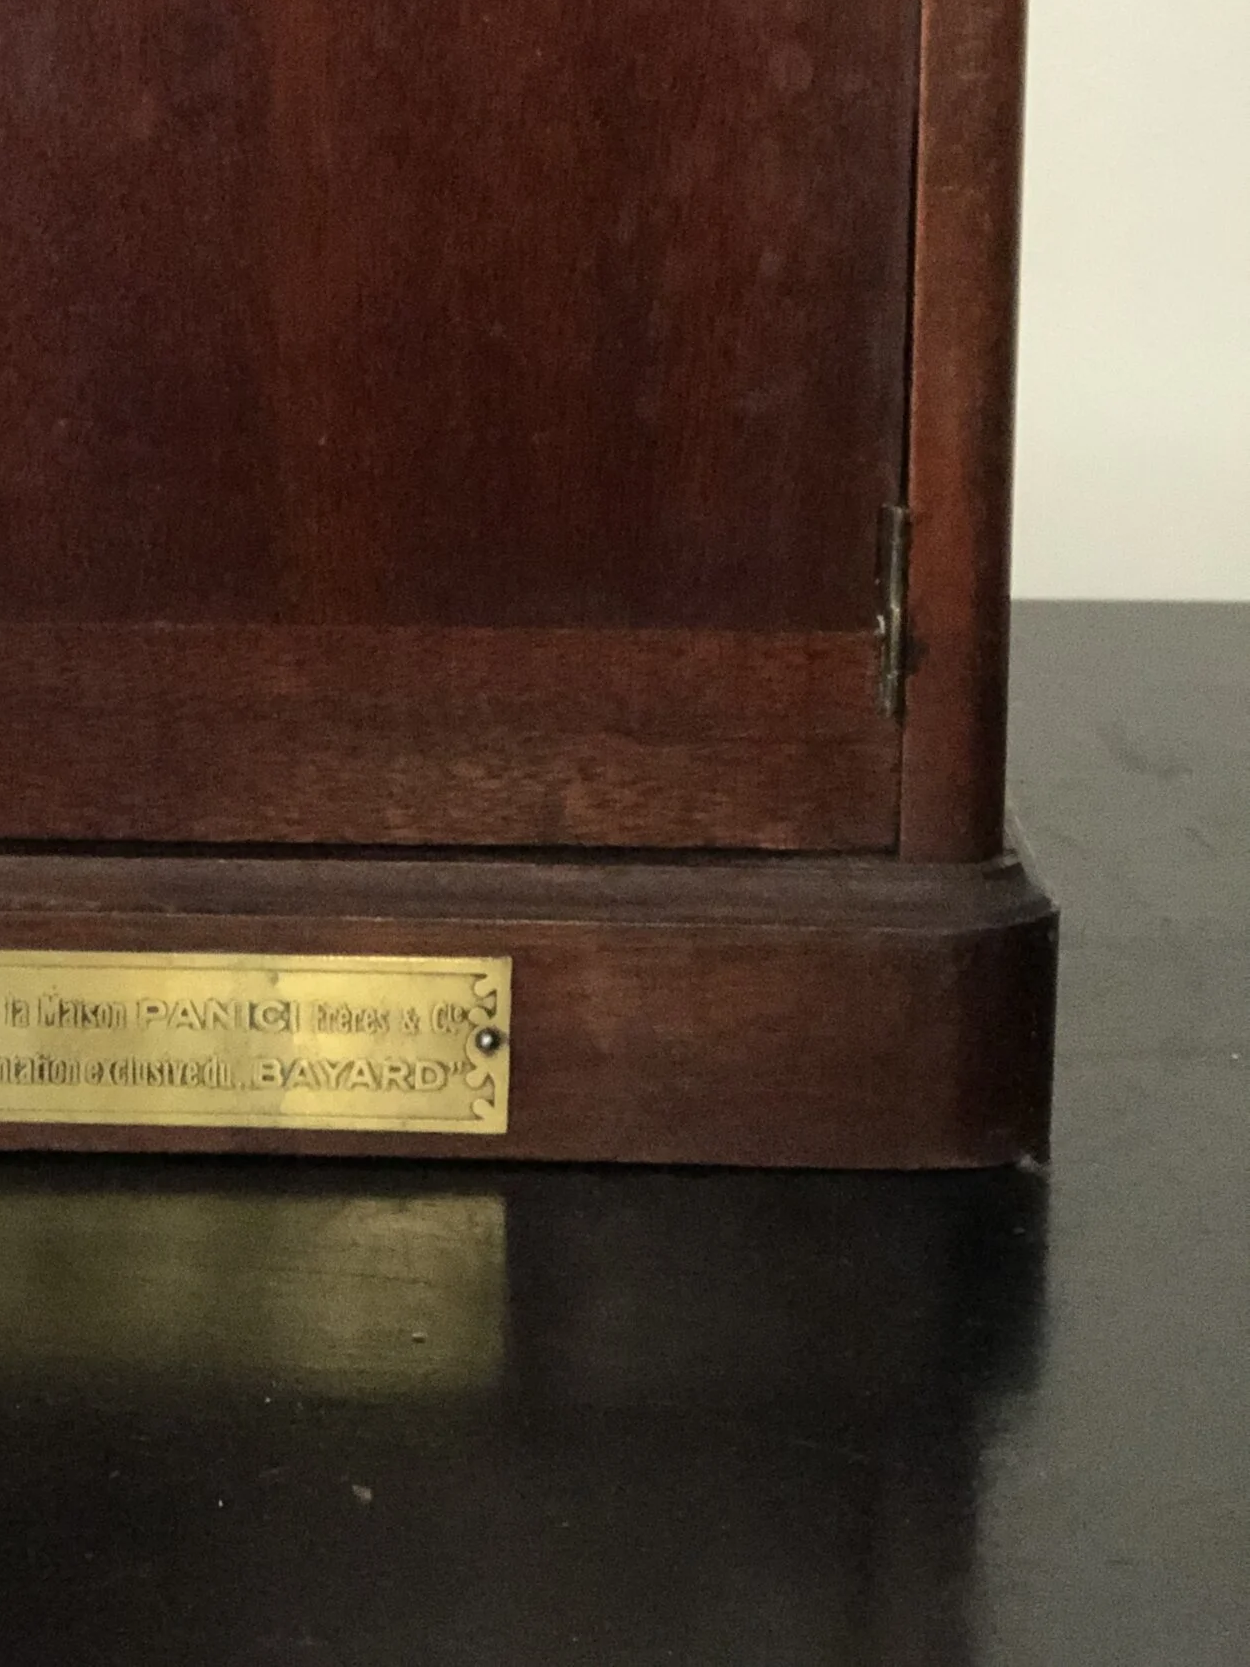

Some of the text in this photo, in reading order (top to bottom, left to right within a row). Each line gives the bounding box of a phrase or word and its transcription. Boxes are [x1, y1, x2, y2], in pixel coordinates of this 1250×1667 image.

[4, 993, 30, 1027] la
[38, 994, 127, 1029] Maison
[402, 1007, 421, 1035] &
[84, 1055, 199, 1088] exclusive
